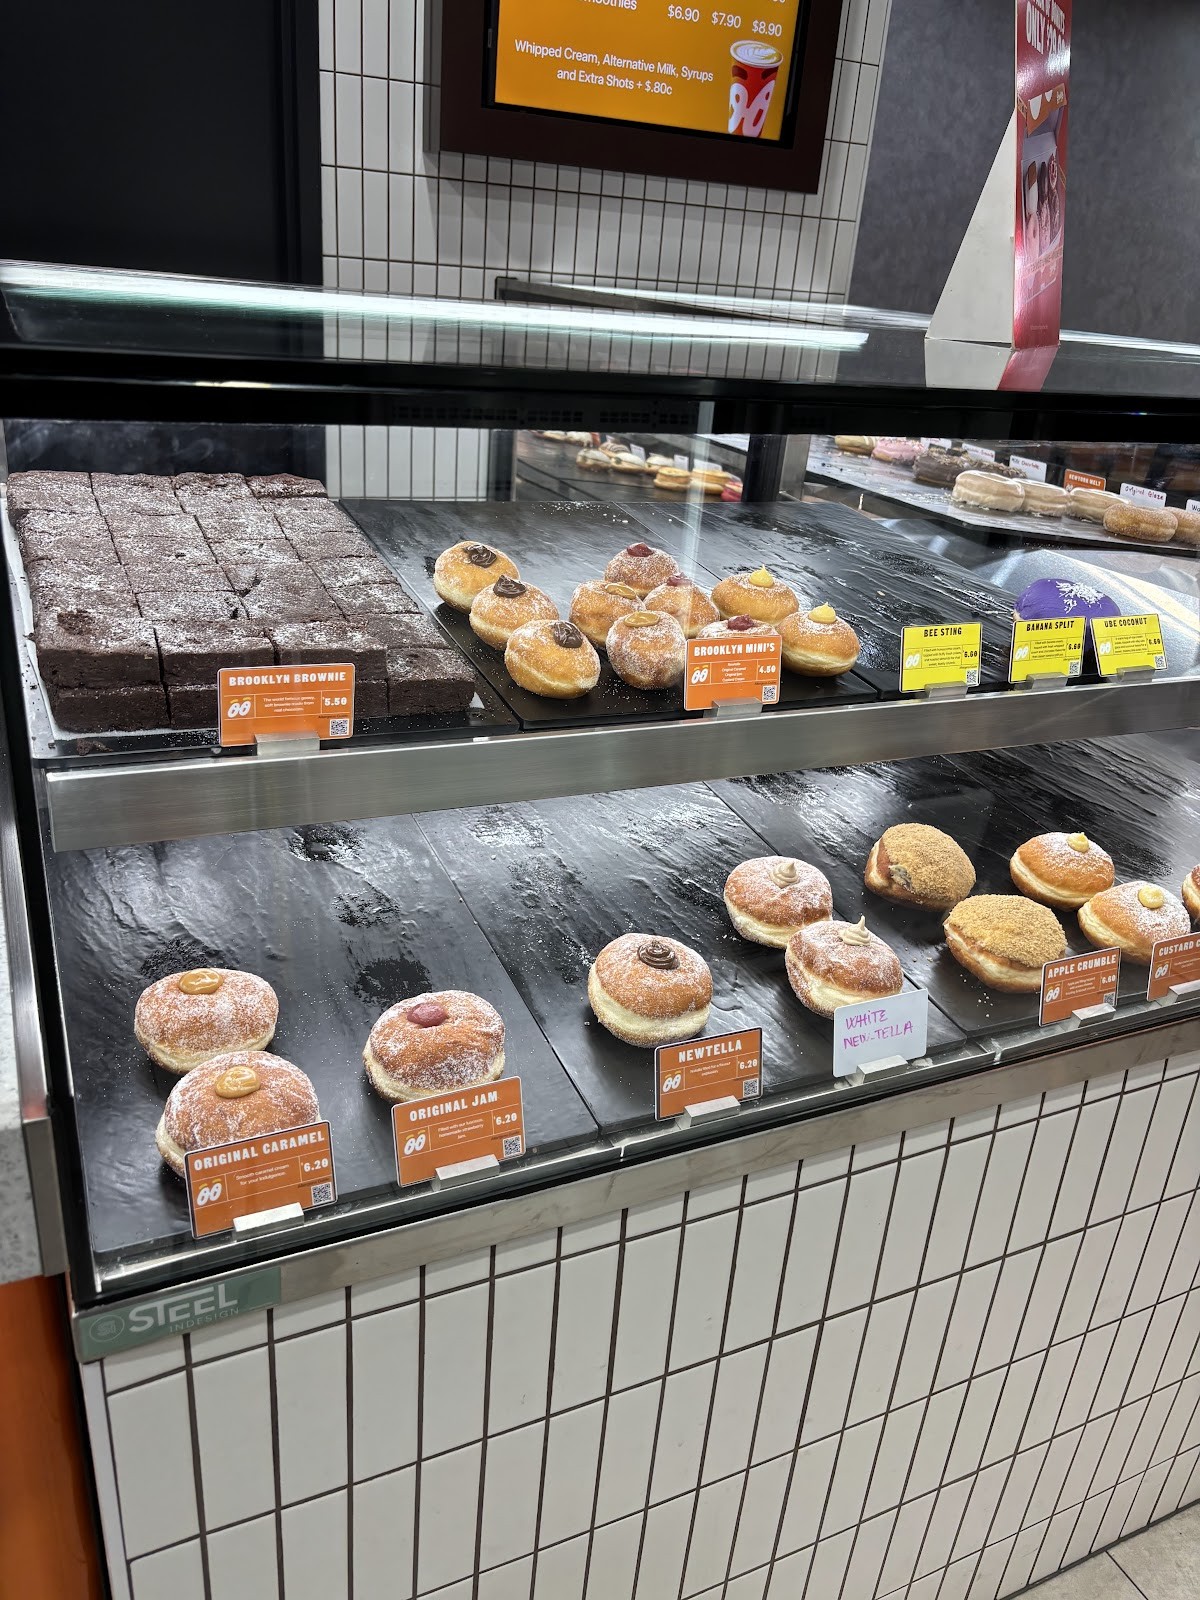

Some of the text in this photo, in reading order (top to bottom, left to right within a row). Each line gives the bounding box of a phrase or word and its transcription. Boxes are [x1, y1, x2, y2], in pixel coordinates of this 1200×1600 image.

[668, 4, 699, 22] $6.90
[711, 11, 741, 28] $7.90
[752, 20, 782, 36] $8.90
[1026, 1, 1045, 54] ONLY
[515, 39, 714, 82] Whipped Cream, Alternative Milk, Syrups
[557, 70, 576, 80] and
[578, 71, 604, 85] Extra
[606, 74, 634, 90] Shots
[644, 80, 672, 96] $.80c
[924, 628, 962, 638] BEE STING
[1026, 620, 1074, 632] BANANA SPLIT
[1119, 618, 1147, 626] COCONUT
[694, 642, 776, 657] BROOKLYN MINI'S
[229, 672, 346, 686] BROOKLYN BROWNIE
[1158, 941, 1194, 956] CUSTARD
[1048, 954, 1116, 979] APPLE CRUMBLE
[678, 1040, 742, 1063] NEWTELLA
[410, 1091, 498, 1122] ORIGINAL JAM
[194, 1131, 324, 1170] ORIGINAL CARAMEL
[129, 1284, 238, 1332] STEEL
[170, 1306, 240, 1332] INDESIGN
